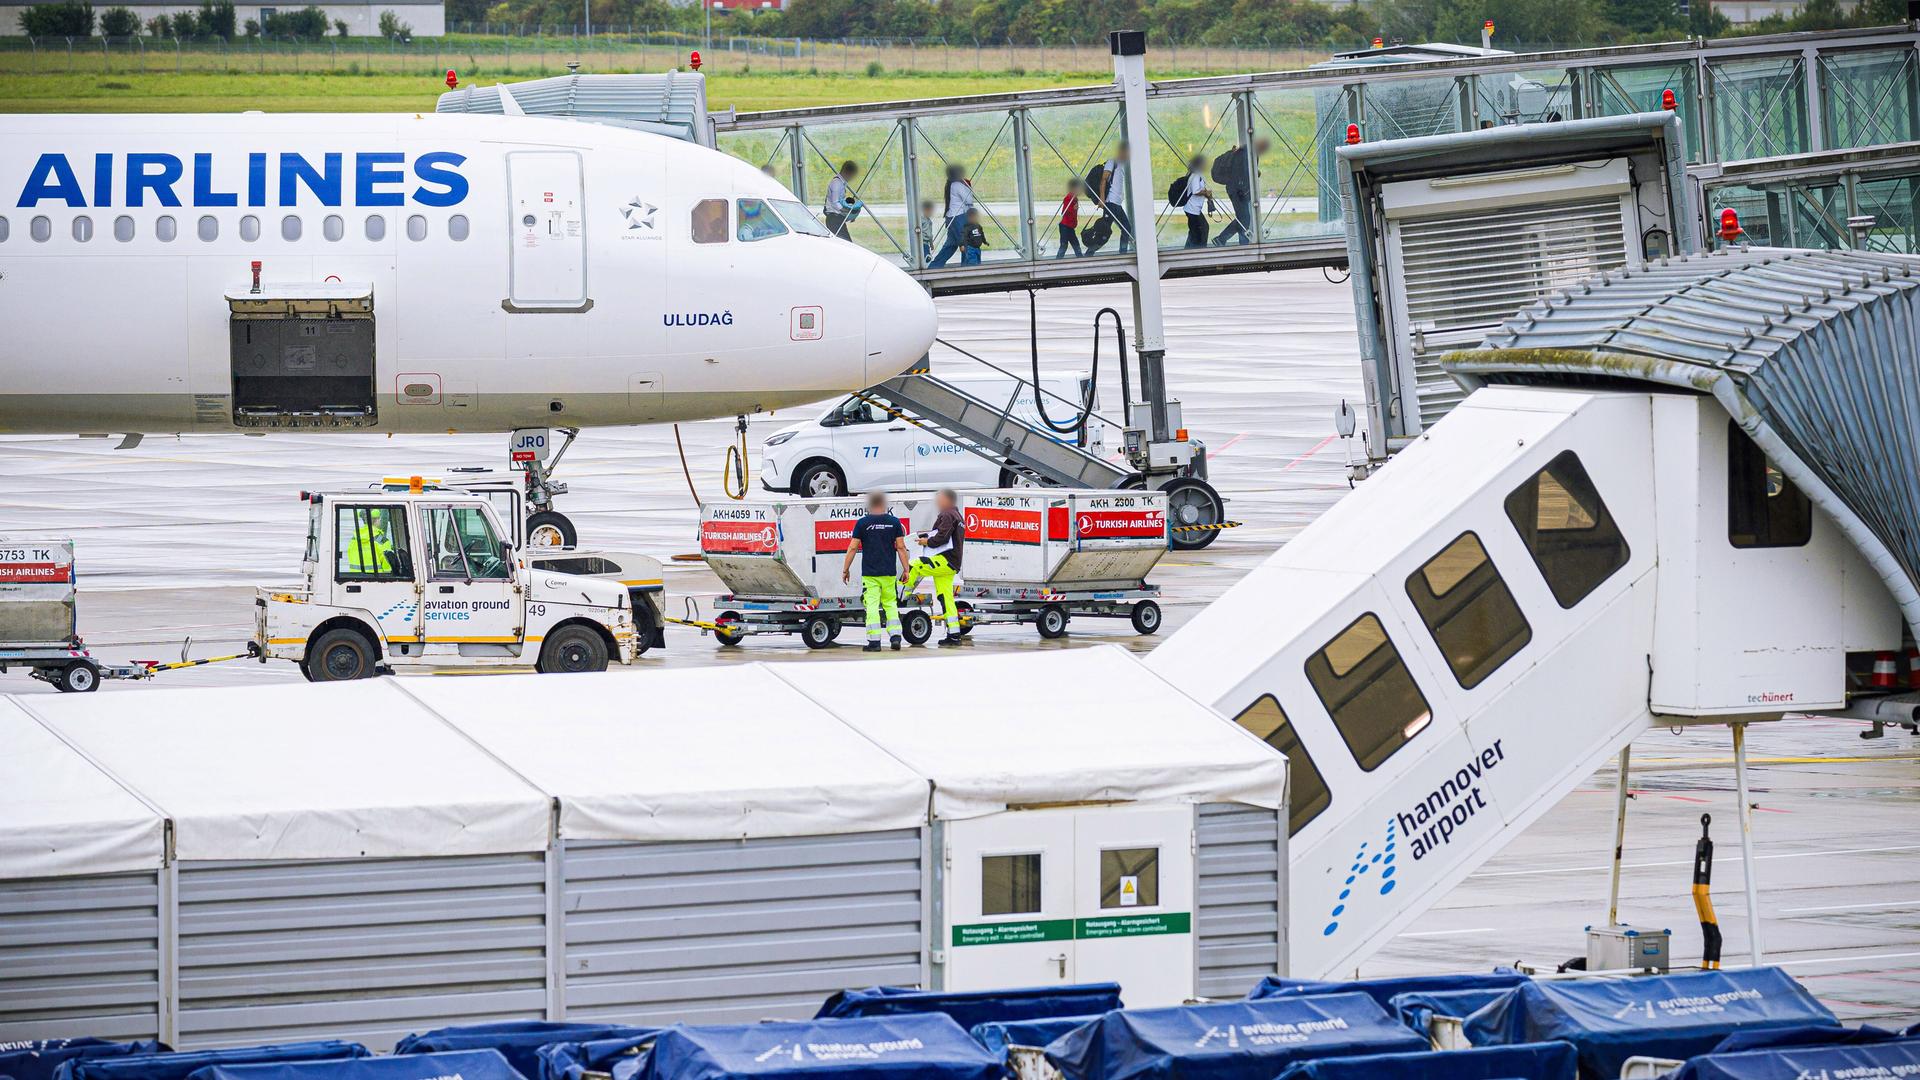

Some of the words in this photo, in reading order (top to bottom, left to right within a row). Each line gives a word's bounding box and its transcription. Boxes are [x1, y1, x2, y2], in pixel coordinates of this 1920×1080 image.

[16, 152, 470, 208] AIRLINES
[663, 310, 734, 326] ULUDAĞ
[305, 326, 315, 335] 11
[863, 446, 879, 458] 77
[976, 497, 993, 506] AKH
[1020, 498, 1030, 507] TK
[1090, 498, 1109, 508] AKH
[1142, 496, 1154, 506] TK
[755, 511, 766, 520] TK
[981, 519, 1009, 529] TURKISH
[1010, 521, 1039, 531] AIRLINES
[1095, 519, 1128, 528] TURKISH
[1129, 519, 1163, 528] AIRLINES
[704, 531, 732, 540] TURKISH
[732, 532, 762, 540] AIRLINES
[33, 549, 50, 560] TK
[16, 568, 55, 576] AIRLINES
[425, 600, 468, 610] aviation
[471, 599, 510, 612] ground
[528, 604, 546, 617] 49
[425, 610, 470, 620] services
[1747, 692, 1793, 703] techünert
[1397, 739, 1504, 837] hannover
[1410, 787, 1487, 861] airport
[1713, 988, 1763, 1005] ground
[1297, 1016, 1349, 1035] ground
